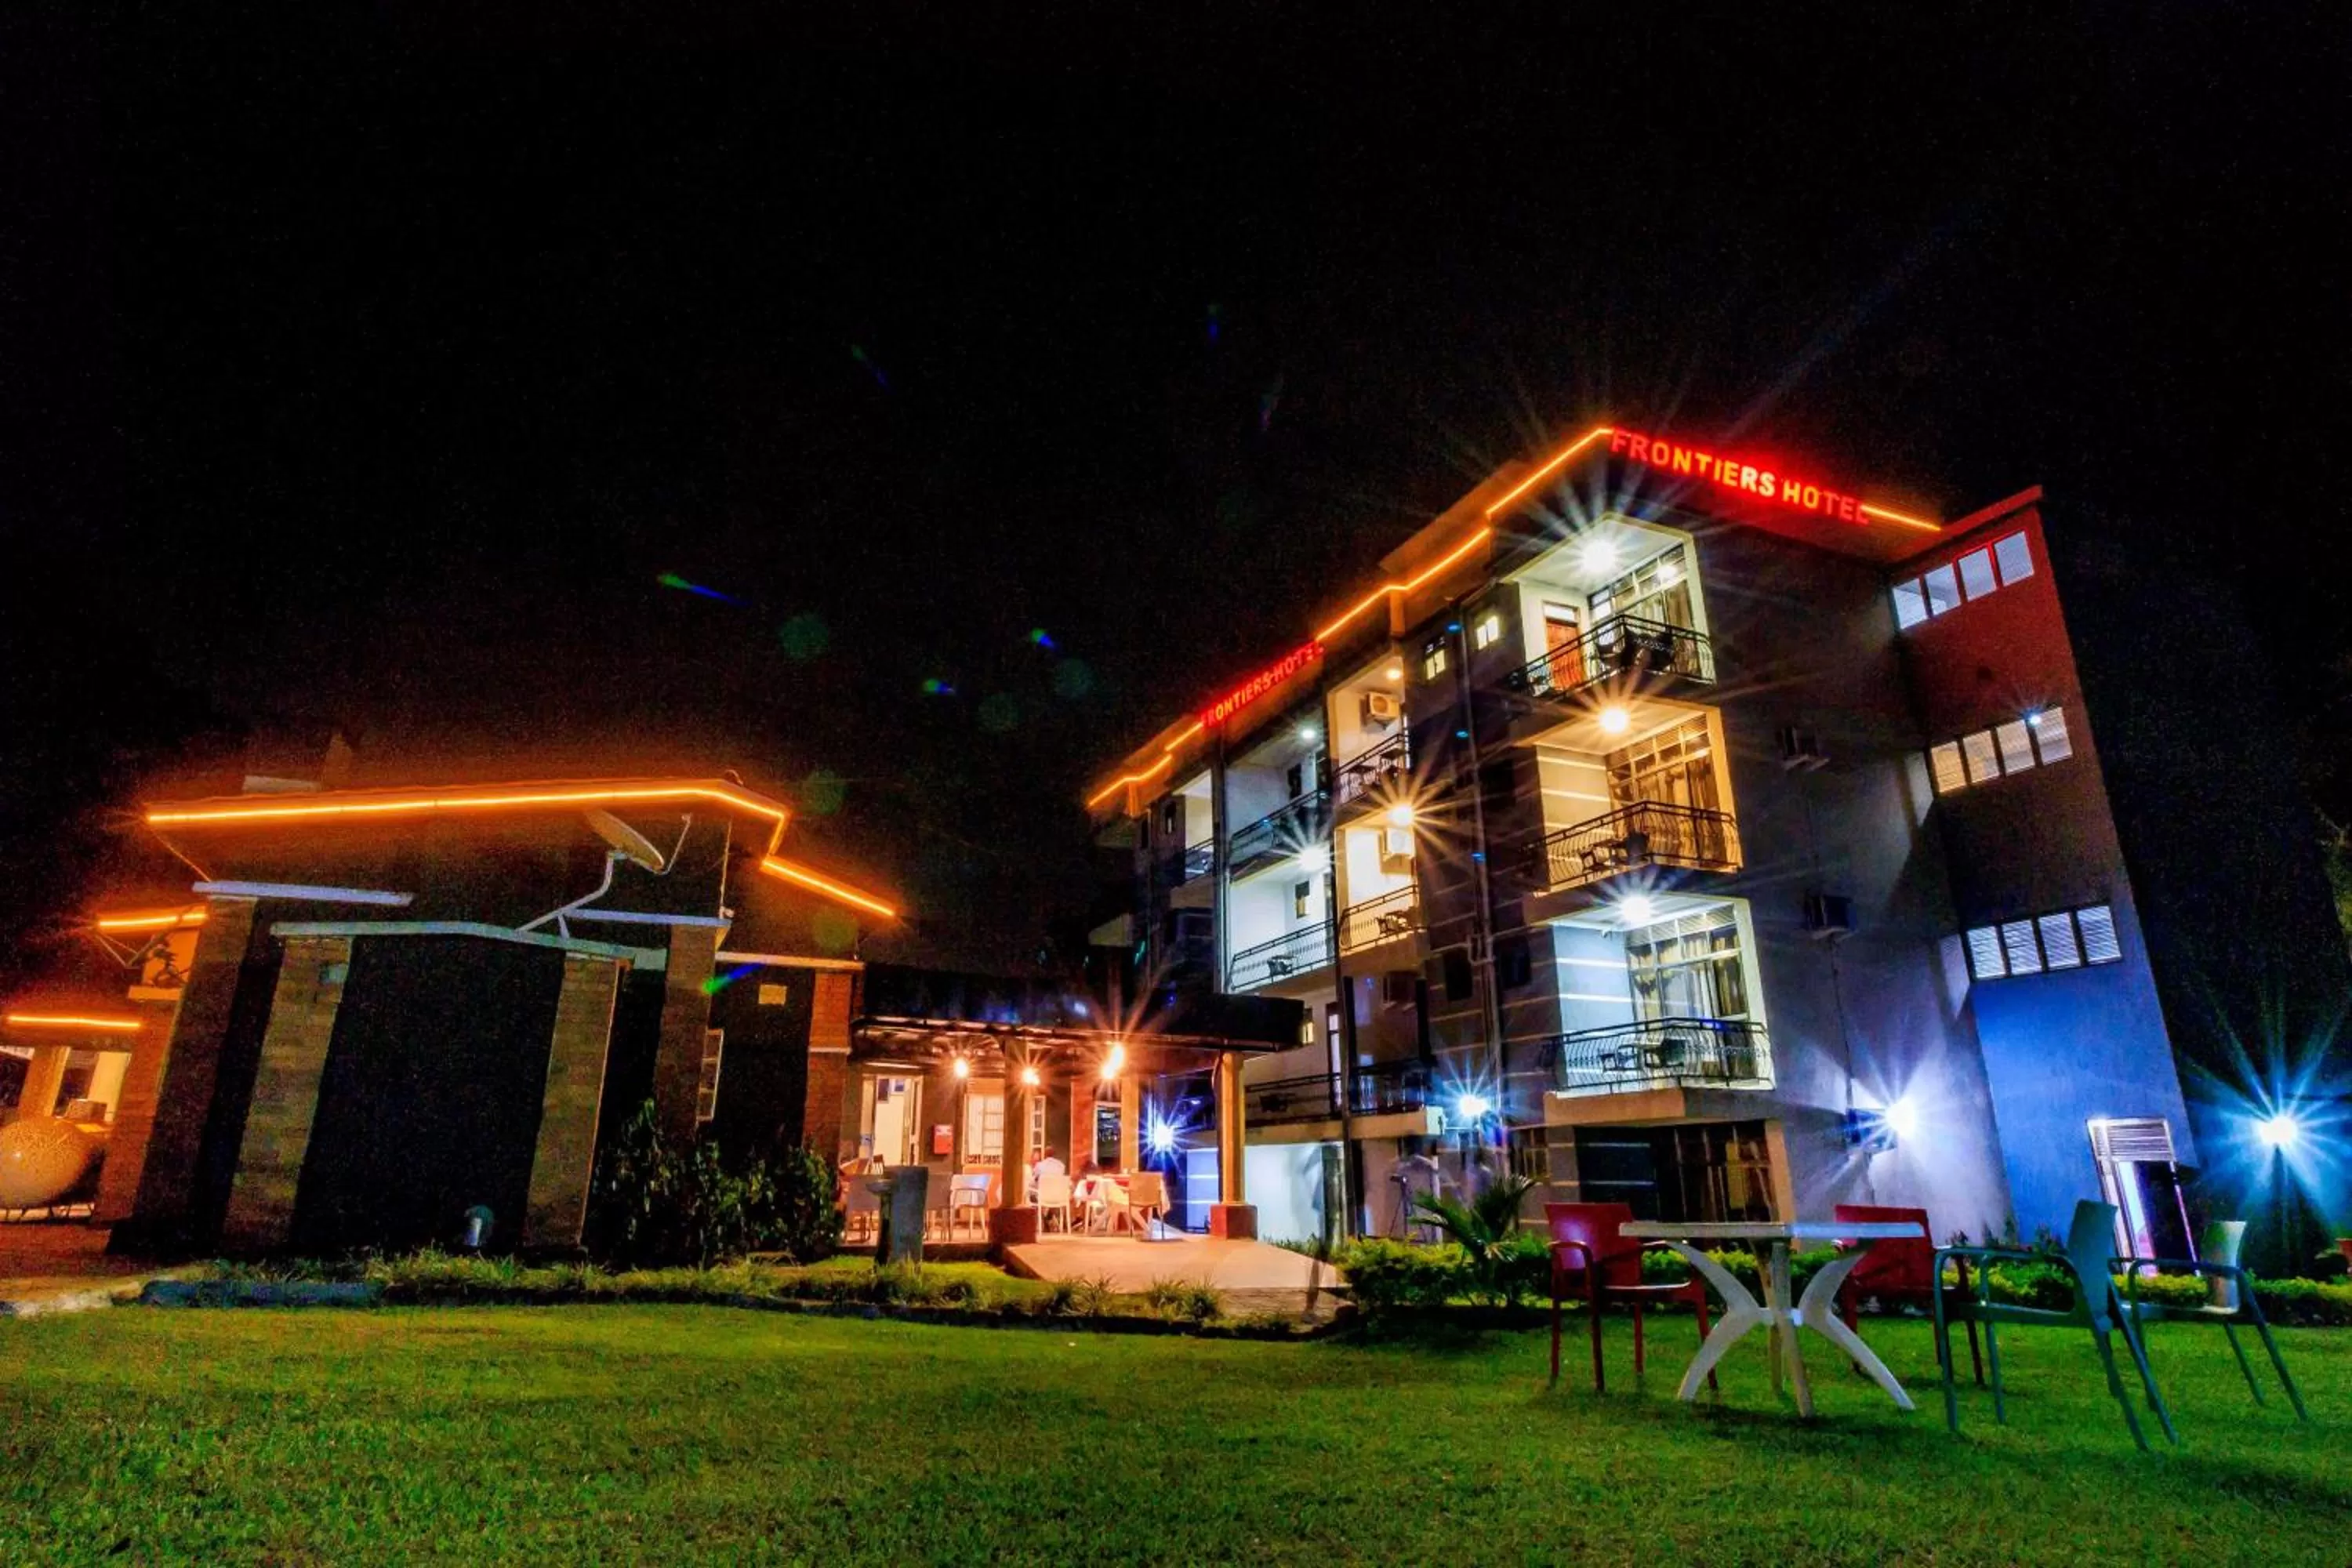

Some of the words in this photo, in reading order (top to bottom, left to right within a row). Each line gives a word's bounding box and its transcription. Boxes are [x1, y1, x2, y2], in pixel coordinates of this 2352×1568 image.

[1611, 427, 1776, 497] FRONTIERS
[1782, 478, 1869, 525] HOTEL
[1201, 671, 1273, 726] FRONTIERS
